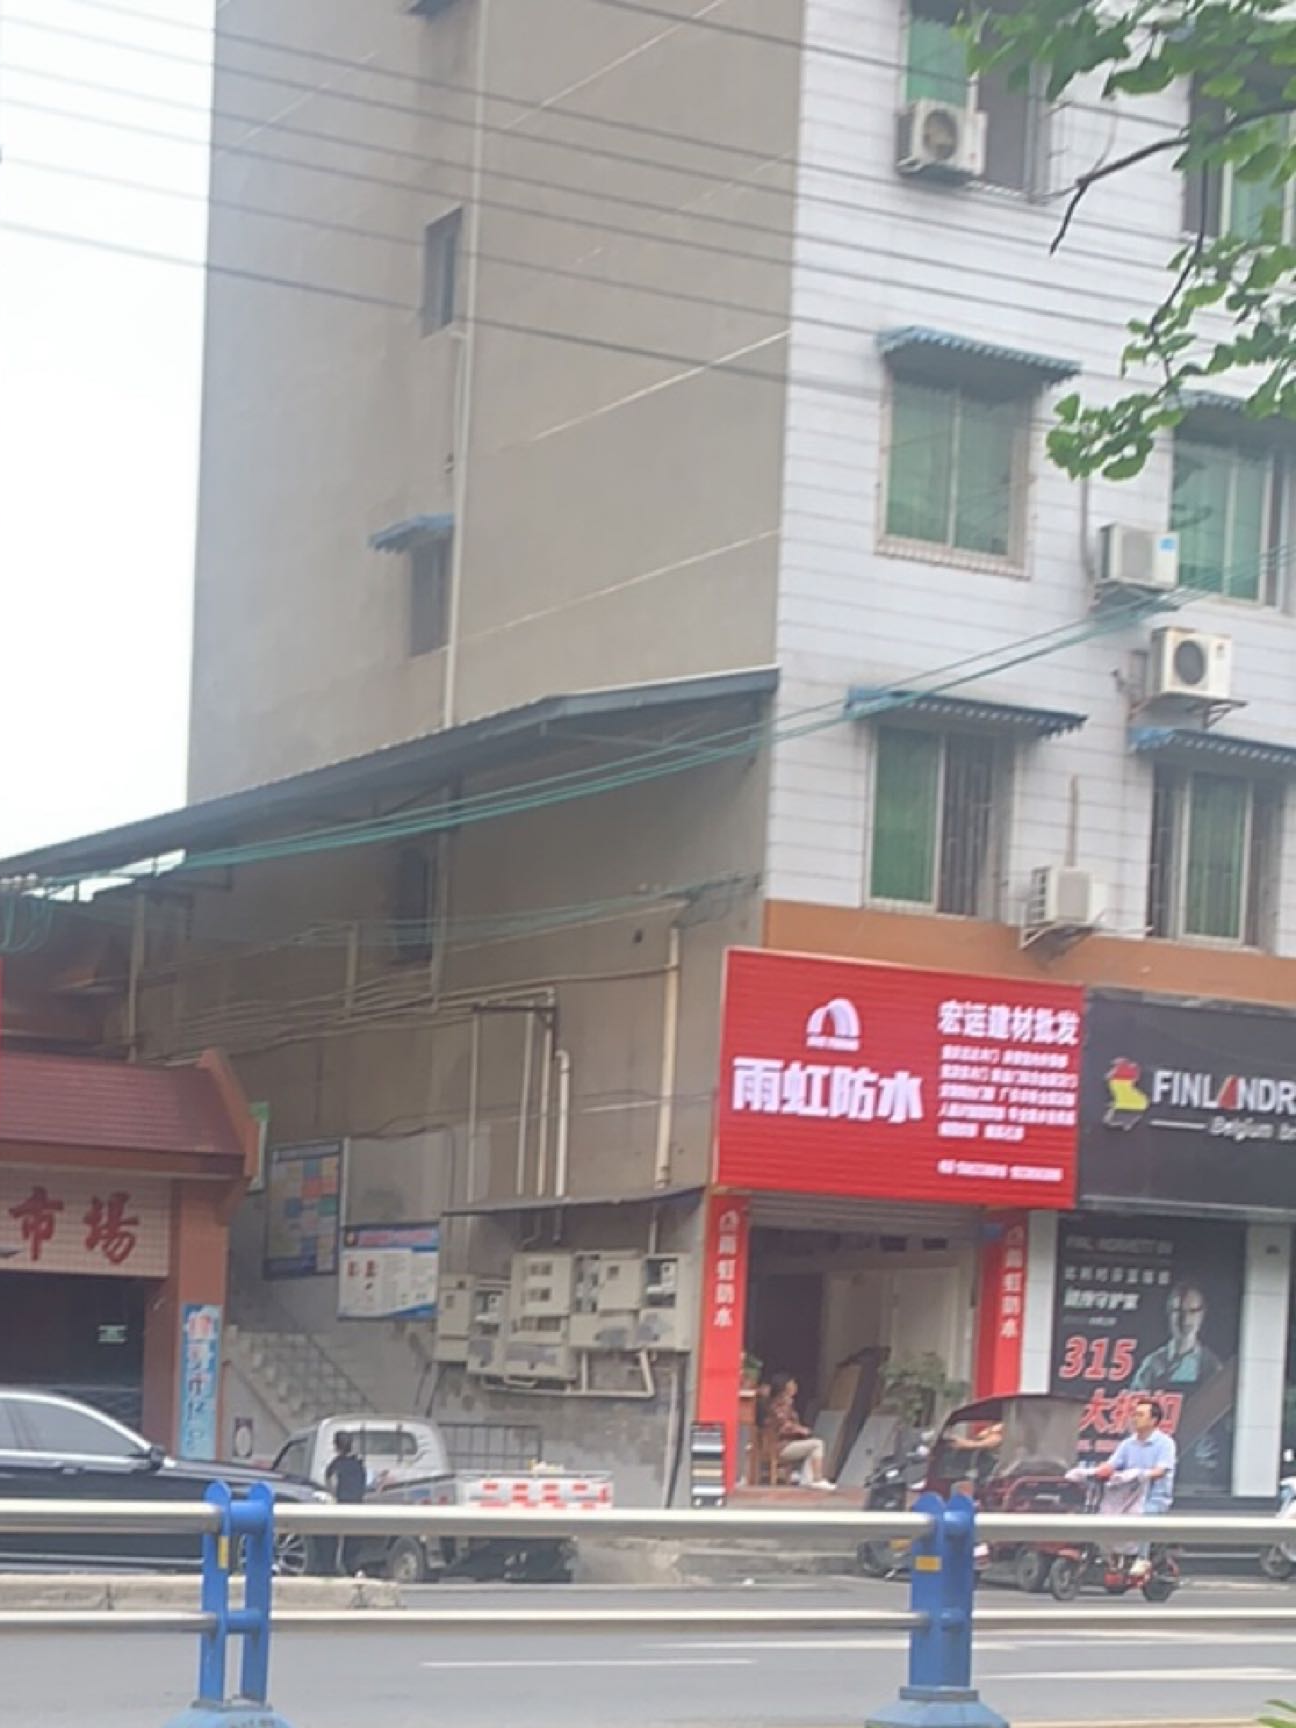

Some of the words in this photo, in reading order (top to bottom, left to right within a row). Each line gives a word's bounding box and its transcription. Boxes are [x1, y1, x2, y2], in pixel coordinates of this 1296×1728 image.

[733, 1056, 924, 1124] 雨虹防水
[1058, 1335, 1138, 1382] 315
